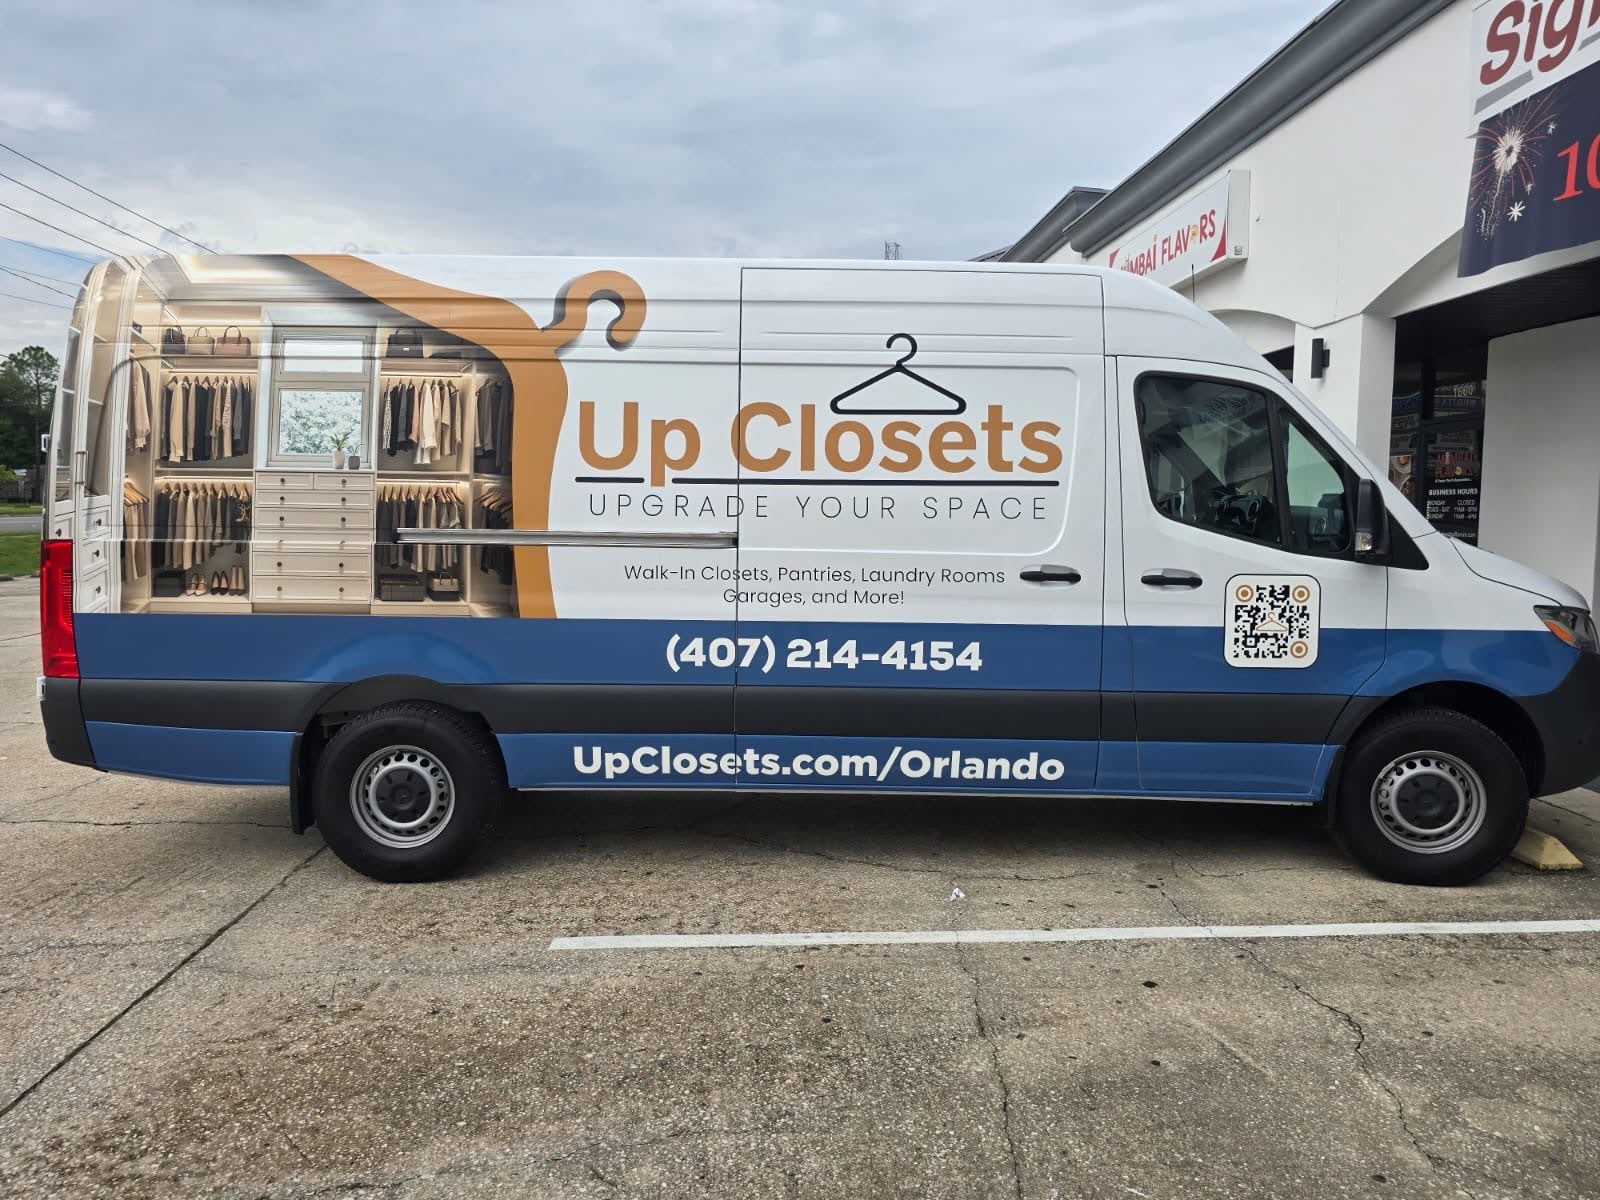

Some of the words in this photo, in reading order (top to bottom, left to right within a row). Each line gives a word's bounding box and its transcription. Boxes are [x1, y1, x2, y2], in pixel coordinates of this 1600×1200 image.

[1121, 234, 1158, 276] MBAI
[1161, 209, 1216, 266] FLAVORS
[579, 401, 701, 487] Up
[731, 402, 1063, 473] Closets
[588, 494, 768, 518] UPGRADE
[796, 496, 896, 519] YOUR
[923, 496, 1047, 520] SPACE
[1428, 488, 1456, 496] BUSINESS
[624, 565, 695, 580] Walk-In
[701, 566, 772, 583] Closets,
[778, 566, 856, 584] Pantries,
[861, 567, 936, 587] Laundry
[941, 568, 1005, 583] Rooms
[723, 589, 806, 608] Garages,
[811, 590, 848, 604] and
[854, 590, 904, 605] More!
[666, 633, 776, 674] (407)
[786, 638, 983, 672] 214-4154
[573, 745, 1066, 782] UpClosets.com/Orlando
